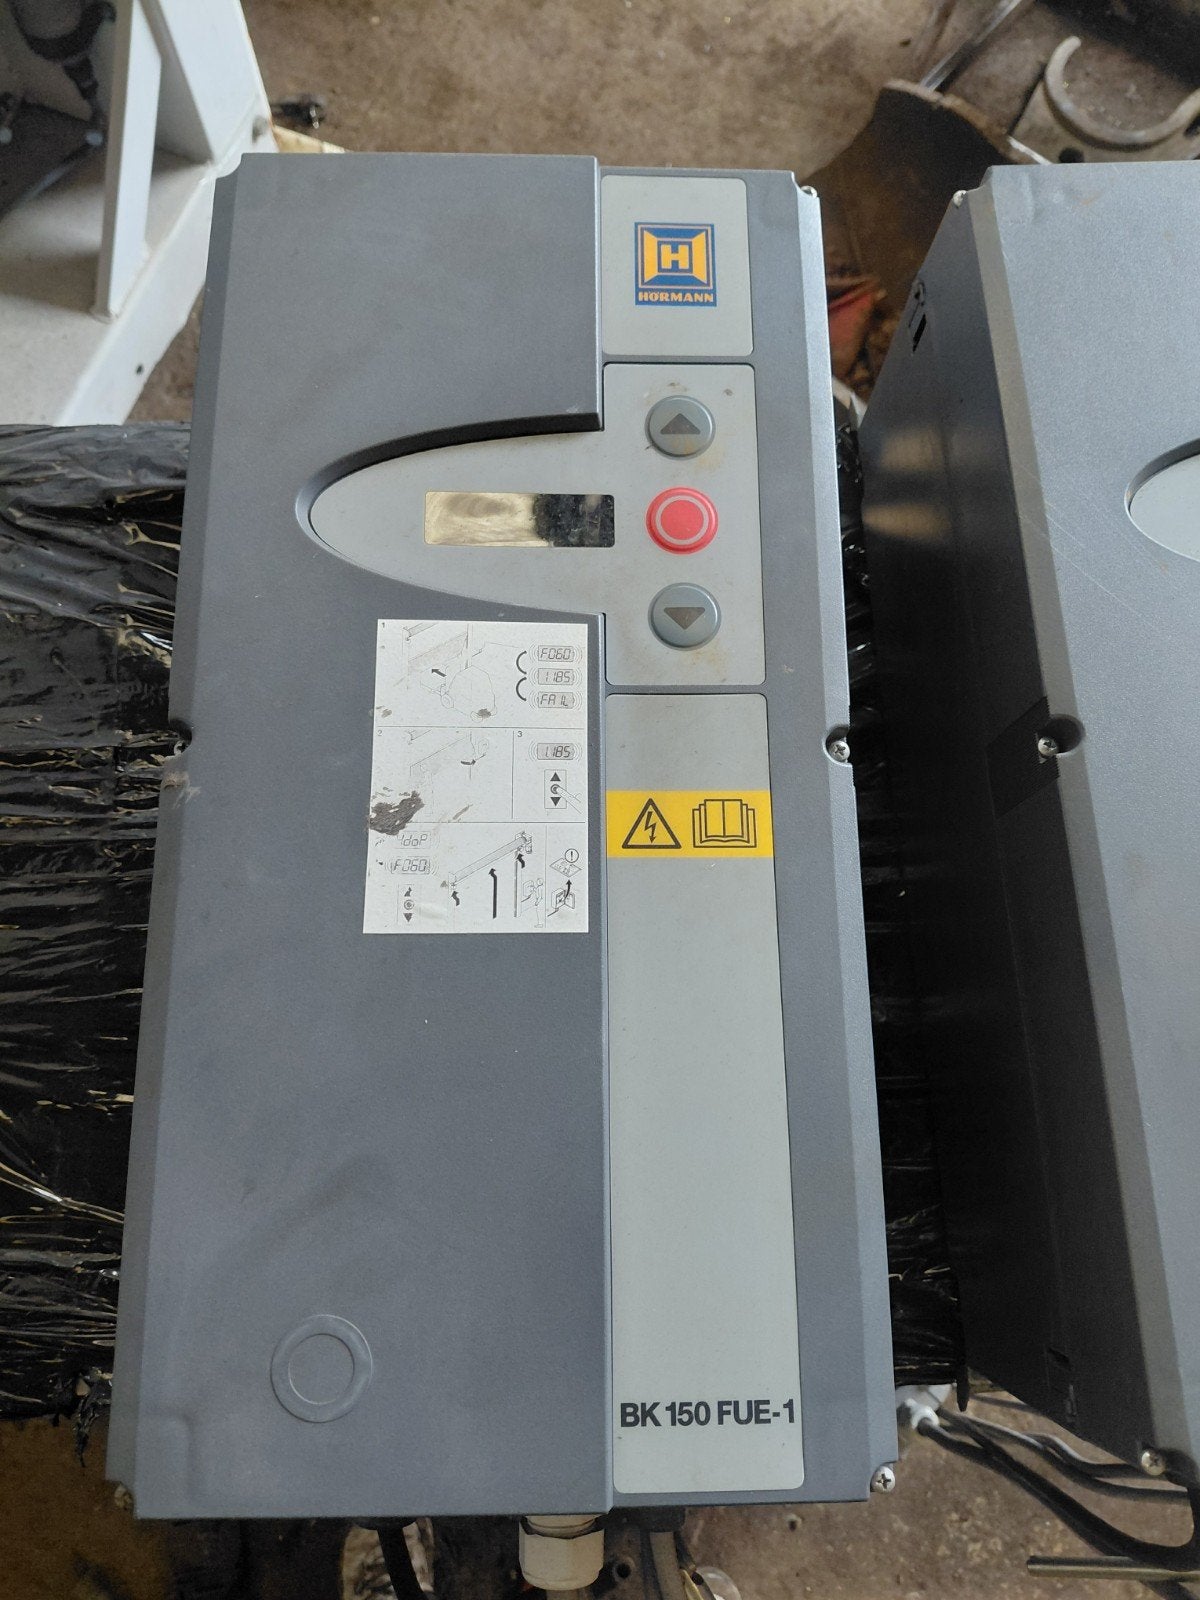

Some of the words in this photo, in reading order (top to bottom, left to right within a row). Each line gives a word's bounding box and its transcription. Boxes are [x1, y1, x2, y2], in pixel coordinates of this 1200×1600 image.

[660, 244, 690, 269] H
[638, 290, 714, 303] HÖRMANN
[540, 694, 569, 707] FAIL
[620, 1402, 662, 1428] BK
[665, 1401, 711, 1427] 150
[717, 1398, 795, 1426] FUE-1
